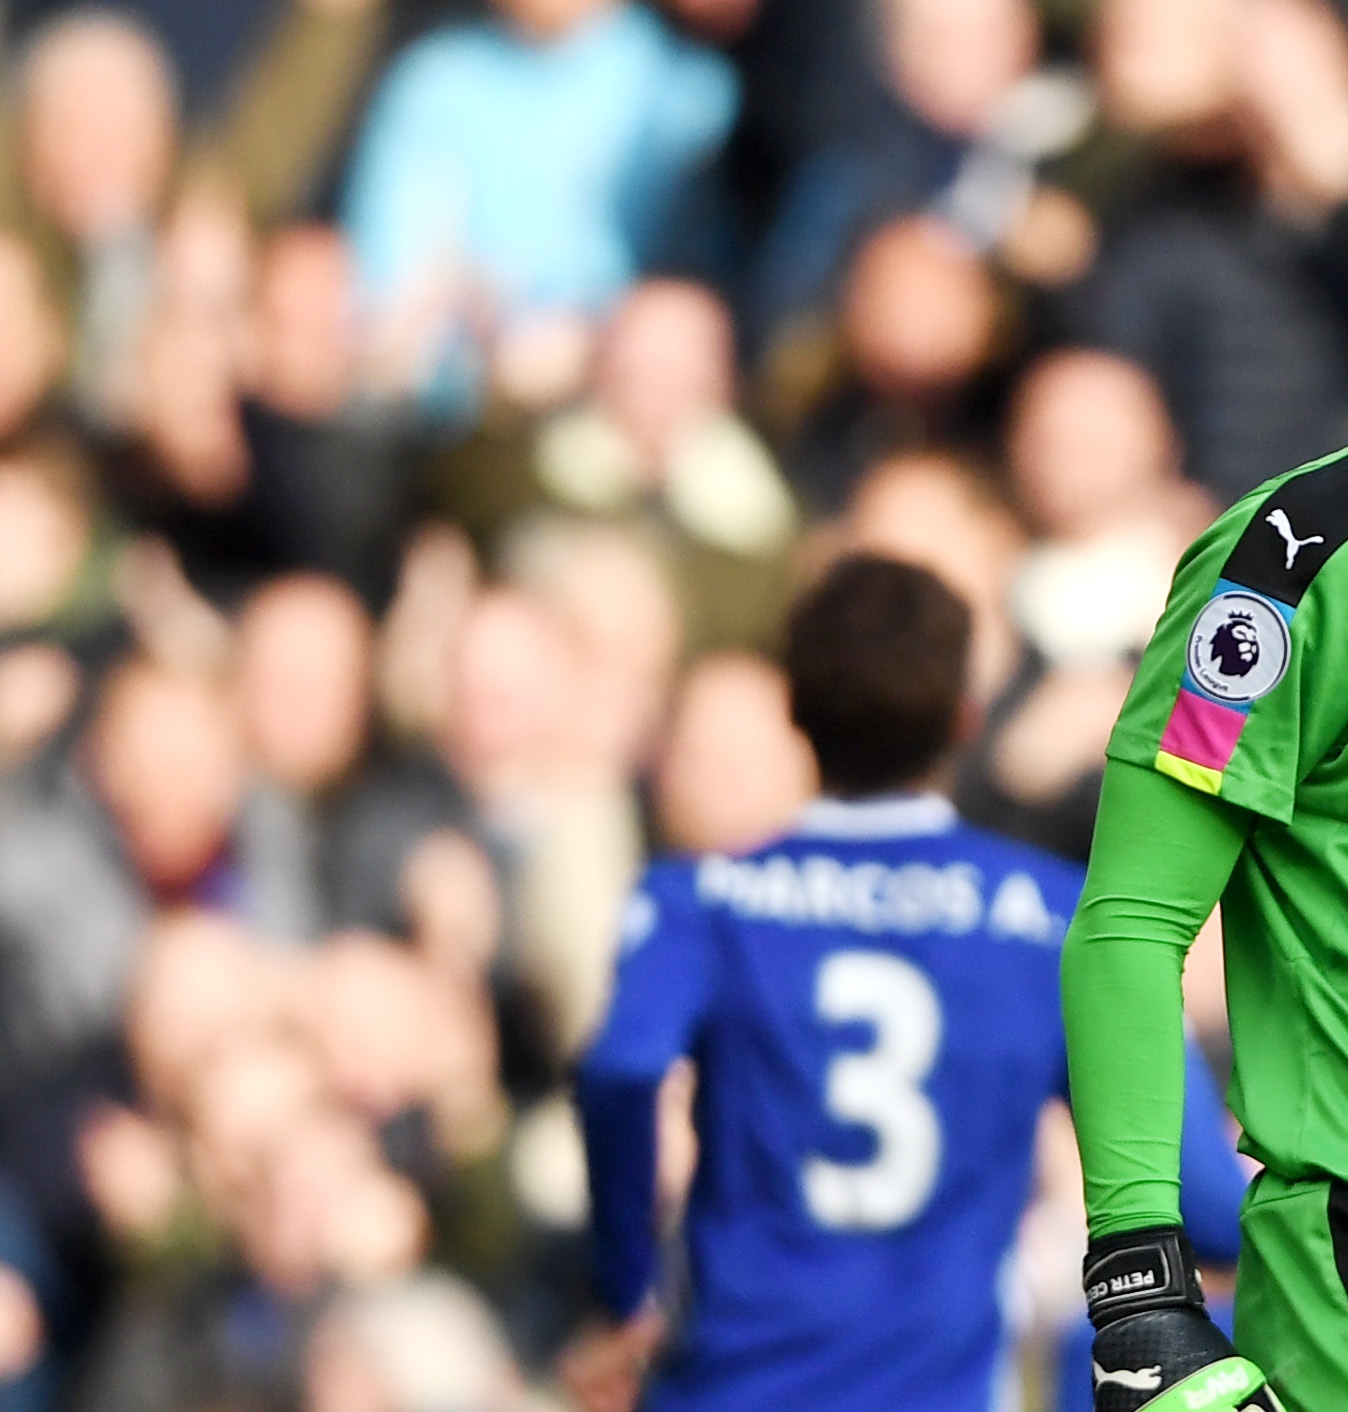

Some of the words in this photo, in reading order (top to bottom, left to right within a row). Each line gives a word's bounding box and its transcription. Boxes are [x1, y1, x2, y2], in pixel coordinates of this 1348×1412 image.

[698, 852, 983, 937] MARCOS
[803, 948, 942, 1234] 3
[1086, 1283, 1109, 1300] CE
[1110, 1269, 1156, 1294] PETR
